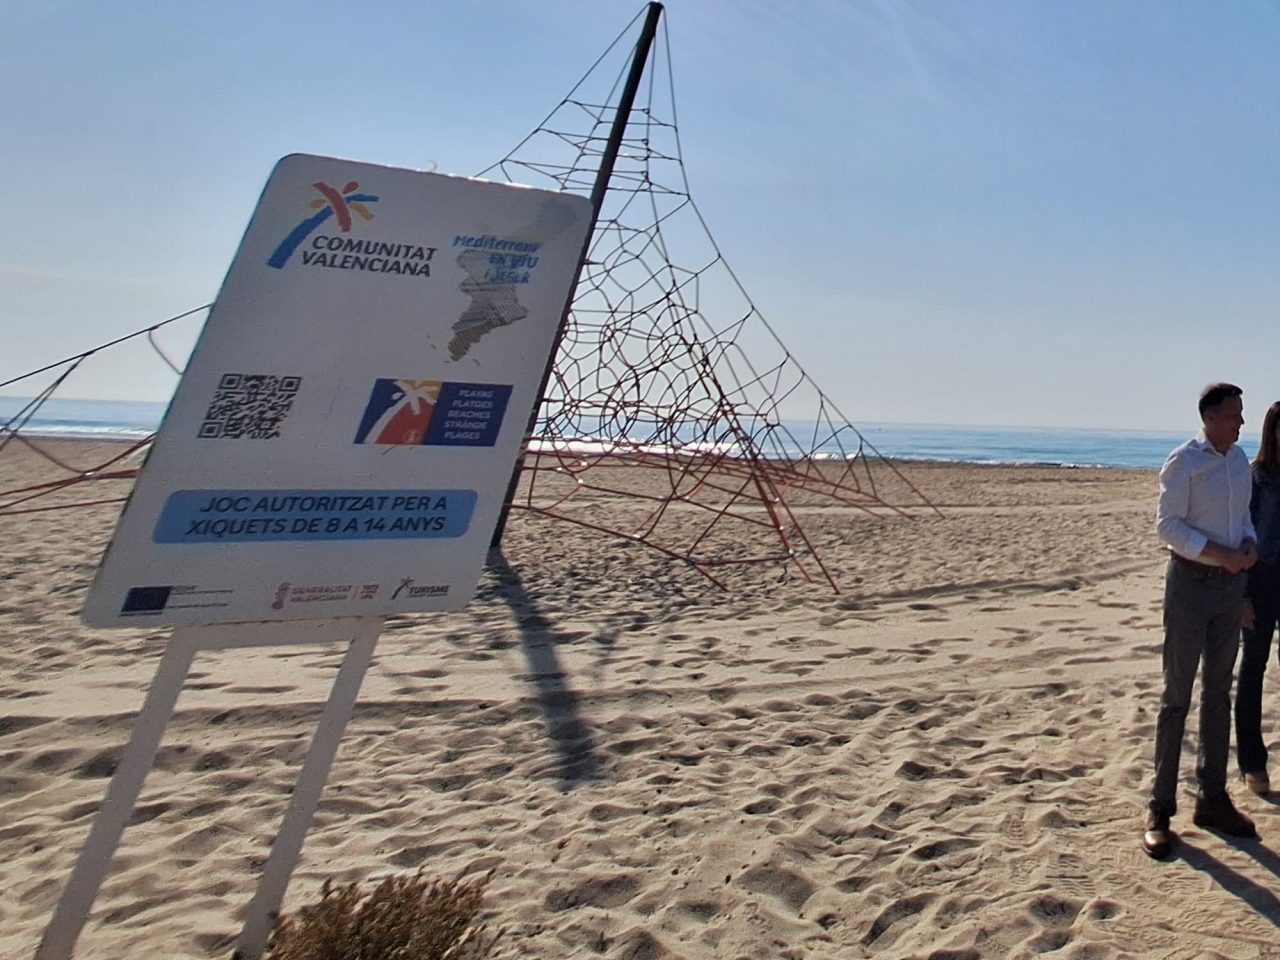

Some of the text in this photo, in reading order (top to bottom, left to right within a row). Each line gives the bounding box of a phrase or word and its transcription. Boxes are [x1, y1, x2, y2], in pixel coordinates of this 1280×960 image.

[311, 235, 438, 261] COMUNITAT
[302, 251, 430, 277] VALENCIANA
[452, 399, 493, 408] PLATGES
[447, 410, 491, 418] BEACHES
[443, 431, 481, 440] PLAGES
[200, 496, 447, 513] JOC AUTORITZAT PER A
[185, 516, 446, 537] XIQUETS DE 8 A 14 ANYS
